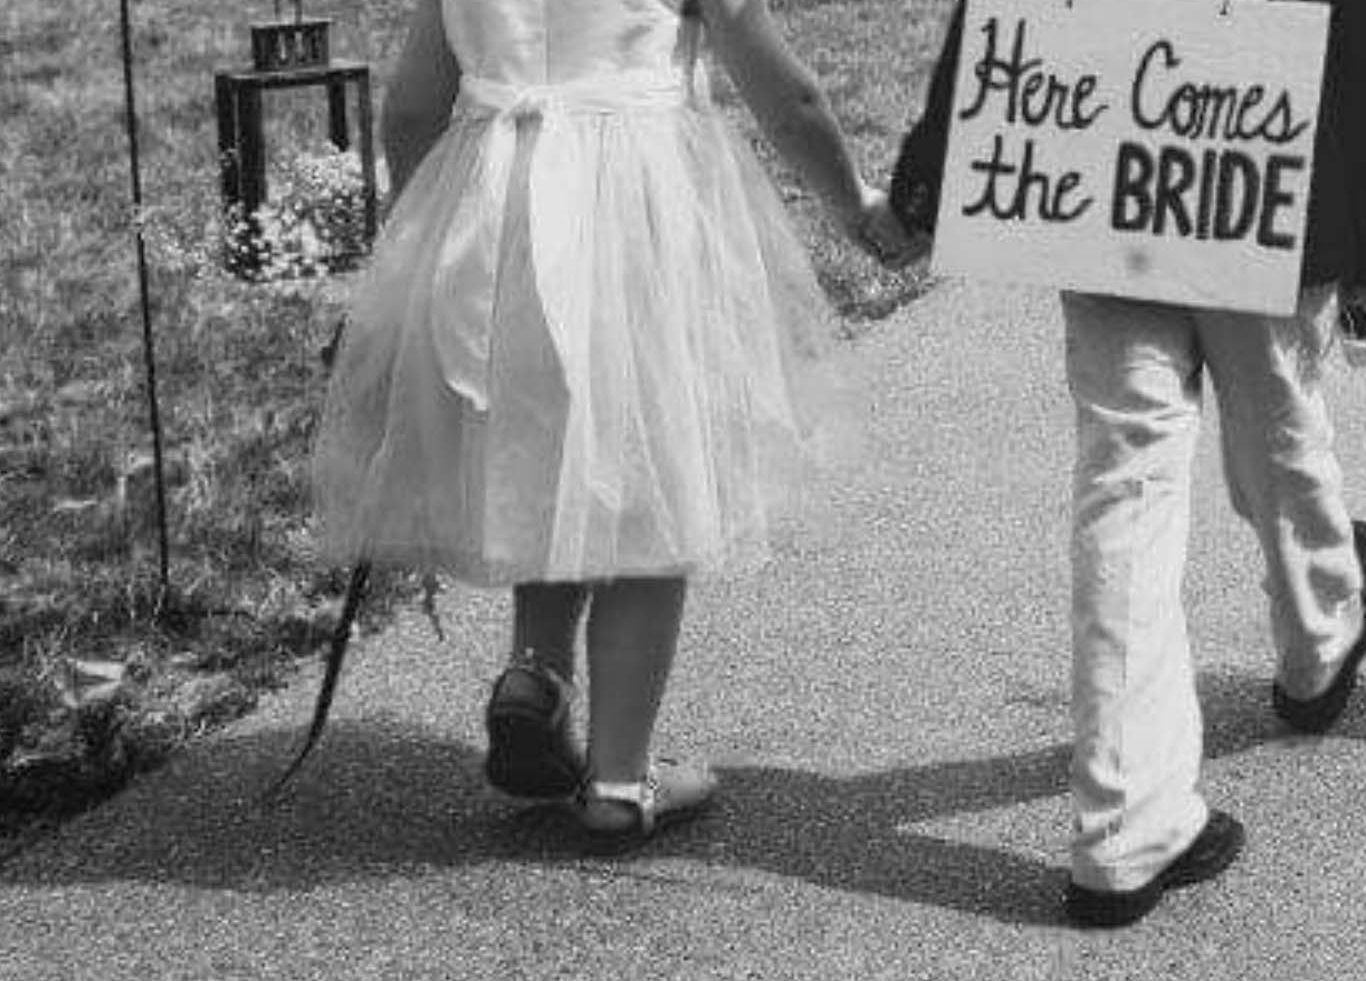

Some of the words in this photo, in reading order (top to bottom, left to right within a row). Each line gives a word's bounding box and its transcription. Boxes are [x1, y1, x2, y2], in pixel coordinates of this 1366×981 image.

[959, 18, 1109, 129] Here
[1132, 40, 1310, 144] Comes
[962, 134, 1094, 222] the
[1111, 141, 1306, 249] BRIDE
